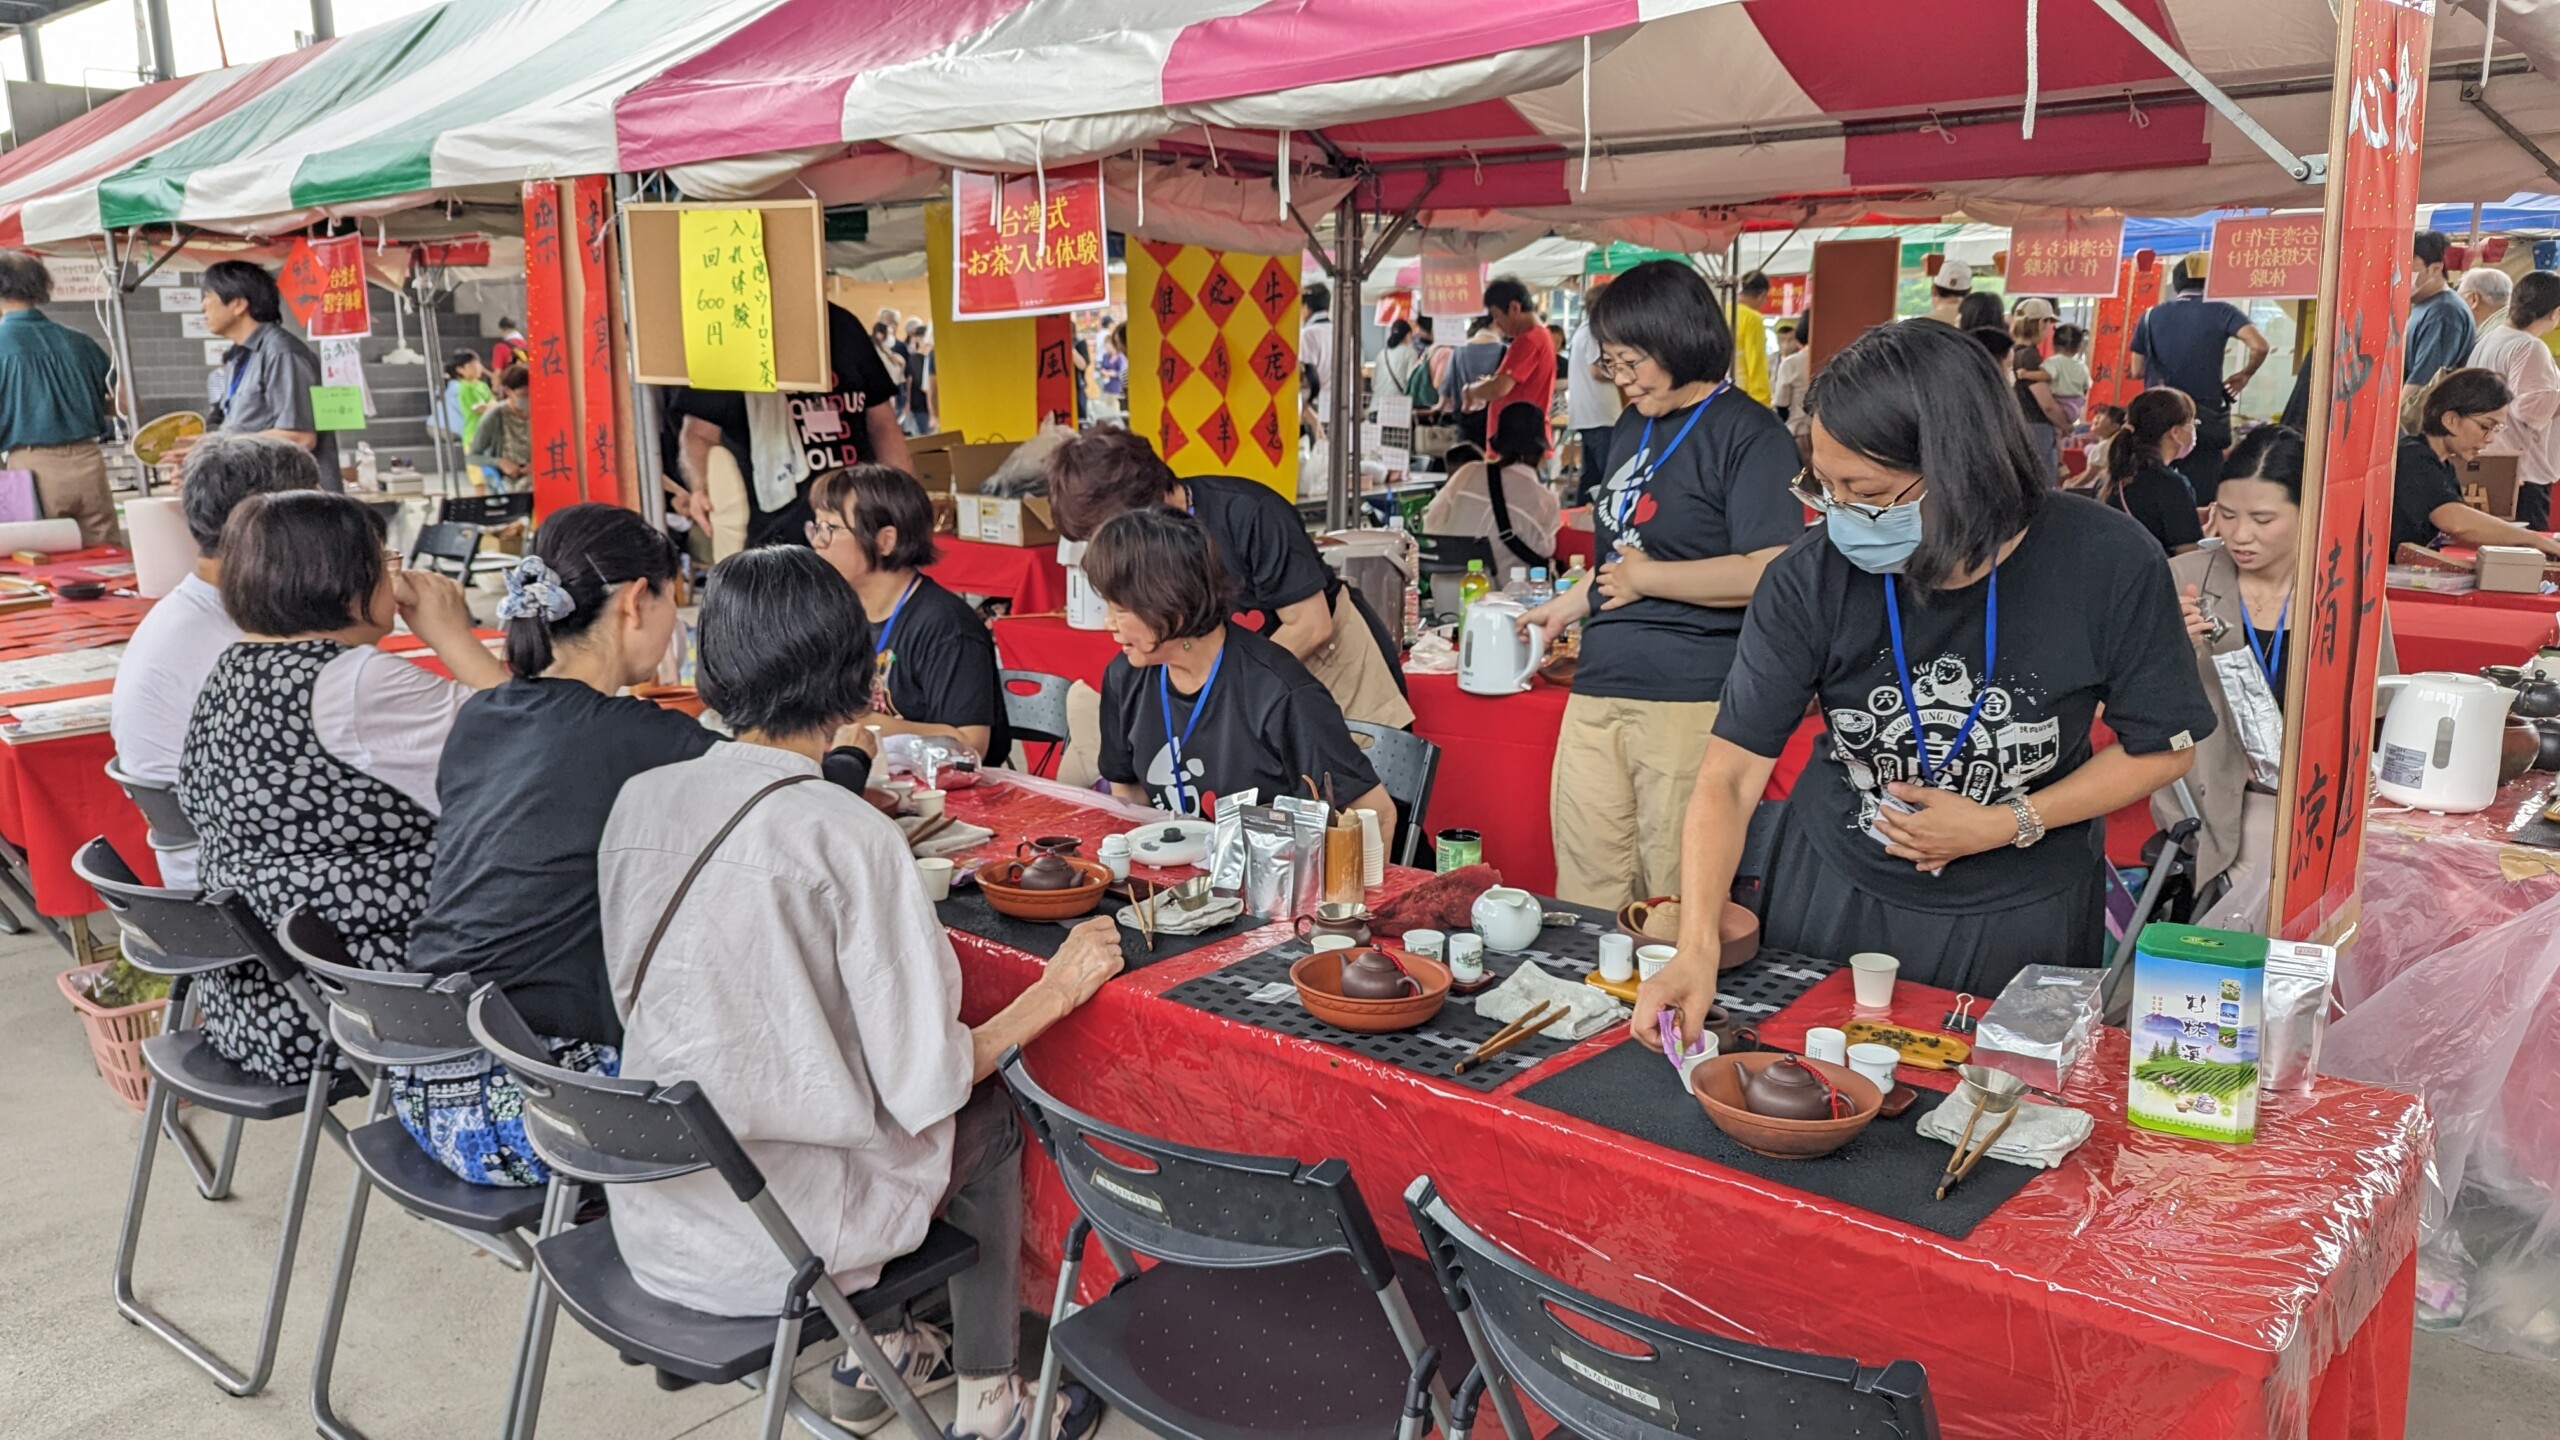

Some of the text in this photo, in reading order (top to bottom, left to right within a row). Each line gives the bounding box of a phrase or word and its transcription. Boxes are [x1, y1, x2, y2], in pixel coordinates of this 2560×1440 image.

[1002, 196, 1071, 238] 台湾式
[967, 230, 1100, 277] お茶入れ体験
[330, 264, 358, 289] 台湾式
[1264, 271, 1283, 315] 牛
[1038, 339, 1070, 380] 風
[1264, 343, 1288, 381] 虎
[1217, 412, 1231, 454] 羊
[1875, 692, 1896, 707] 六
[1982, 693, 2004, 714] 合
[1885, 711, 1944, 740] KAOHUNG
[1946, 713, 1959, 725] IS
